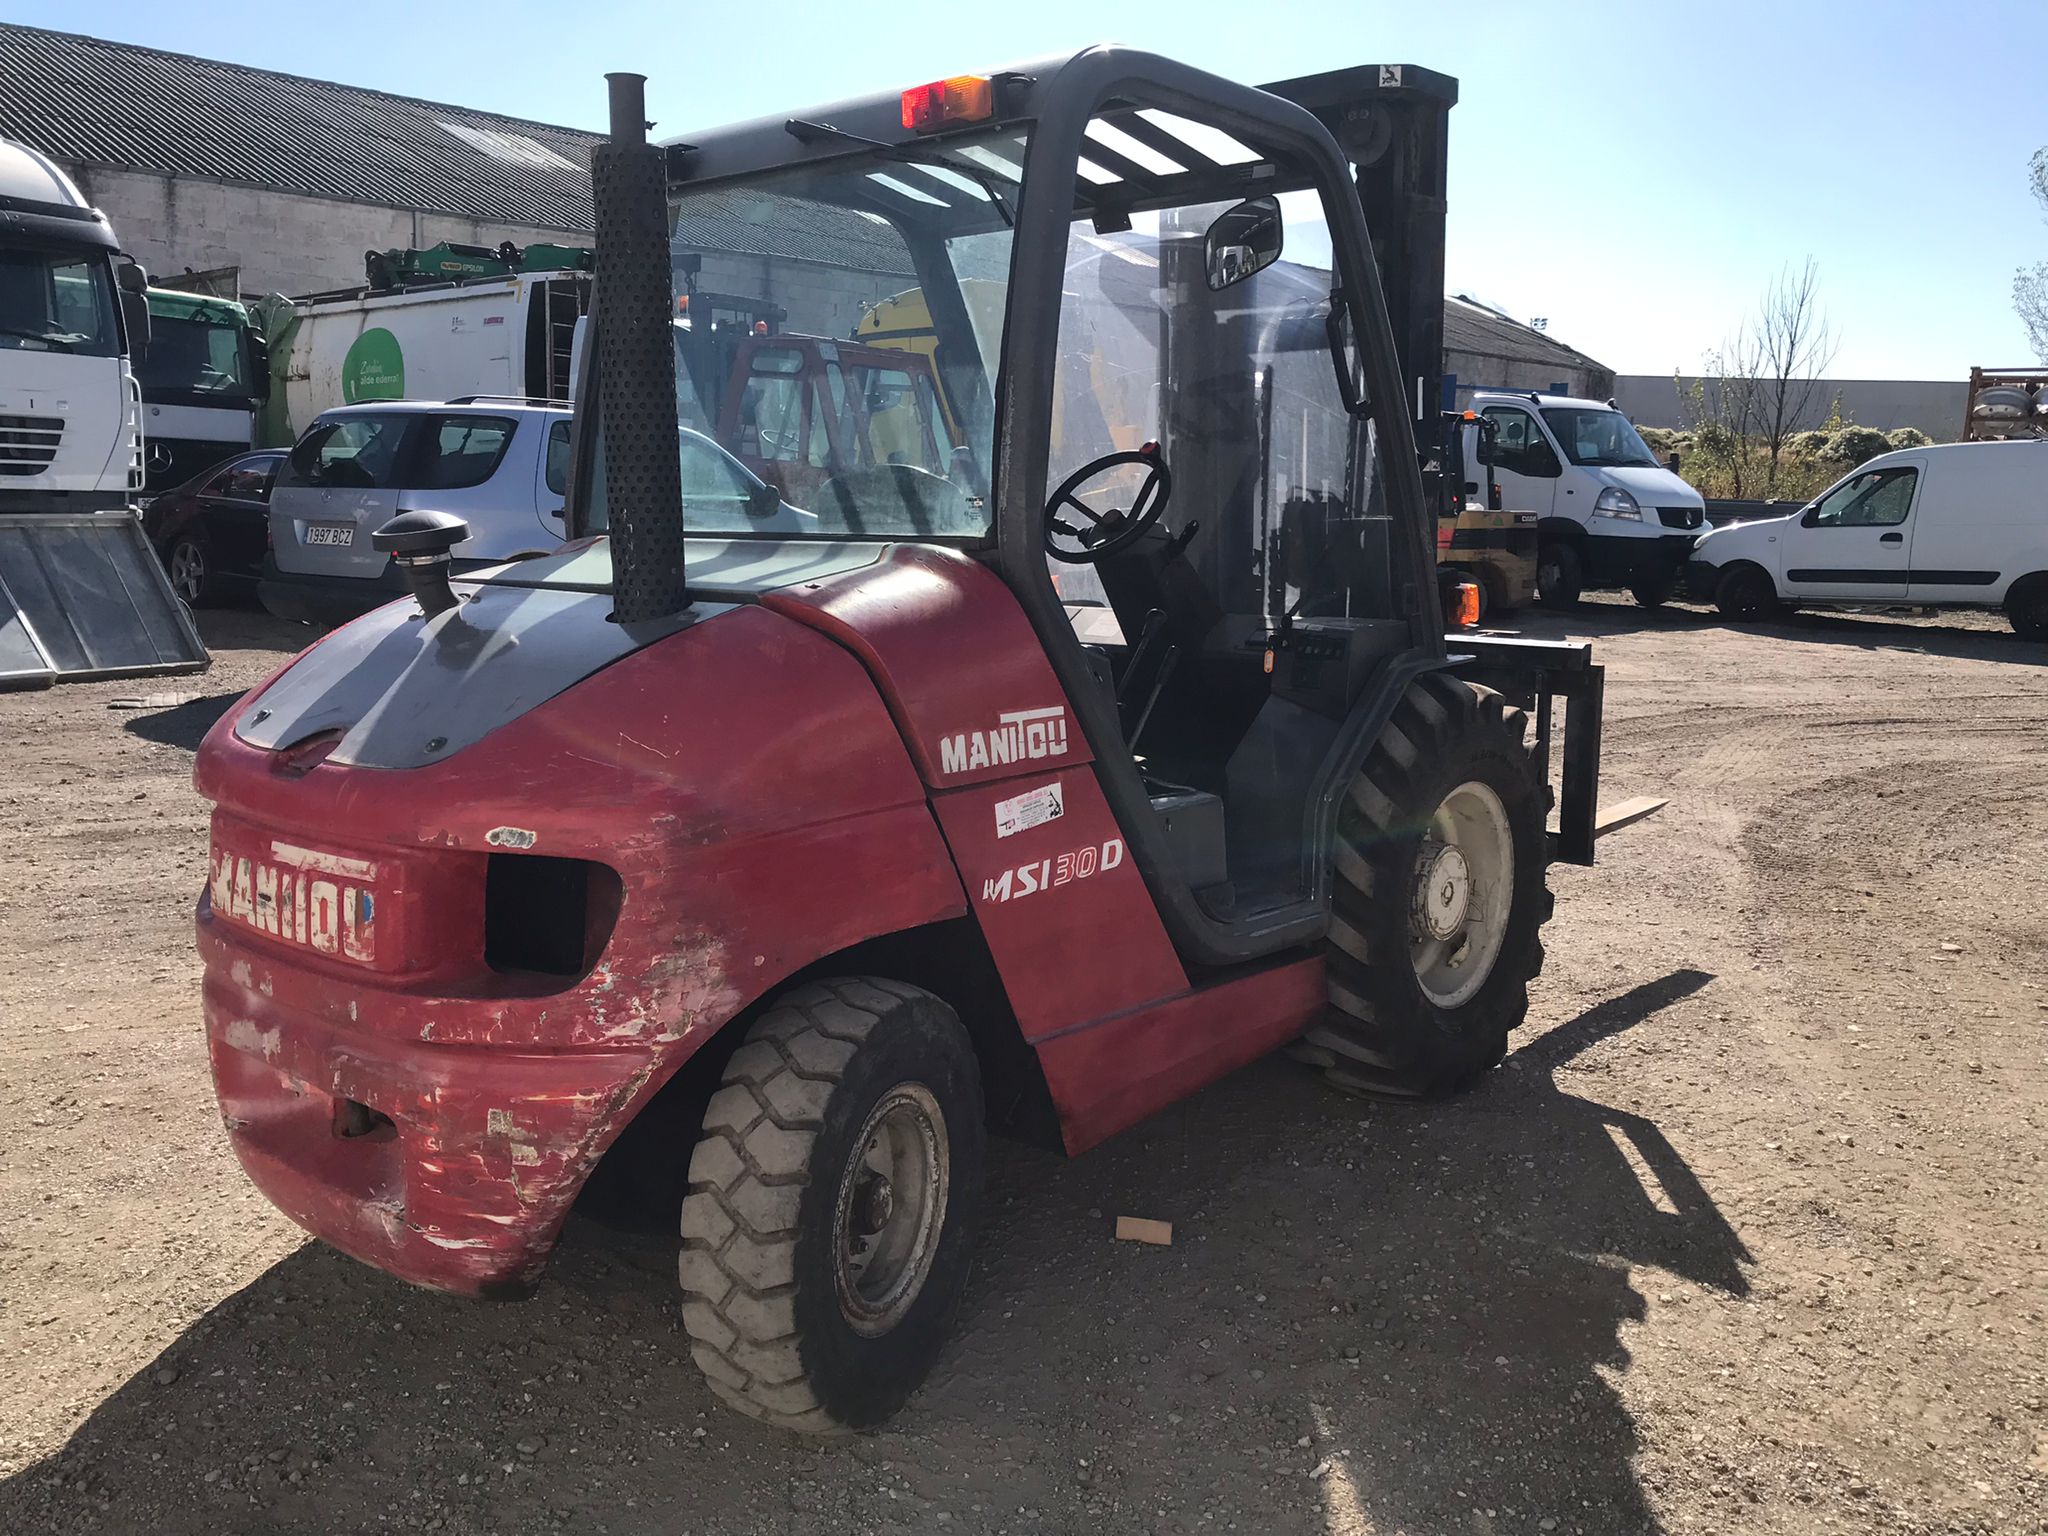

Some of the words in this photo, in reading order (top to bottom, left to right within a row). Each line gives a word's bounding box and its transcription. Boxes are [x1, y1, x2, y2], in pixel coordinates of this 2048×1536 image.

[309, 528, 331, 543] 1997
[331, 529, 351, 544] BCZ
[941, 706, 1068, 774] MANITOU
